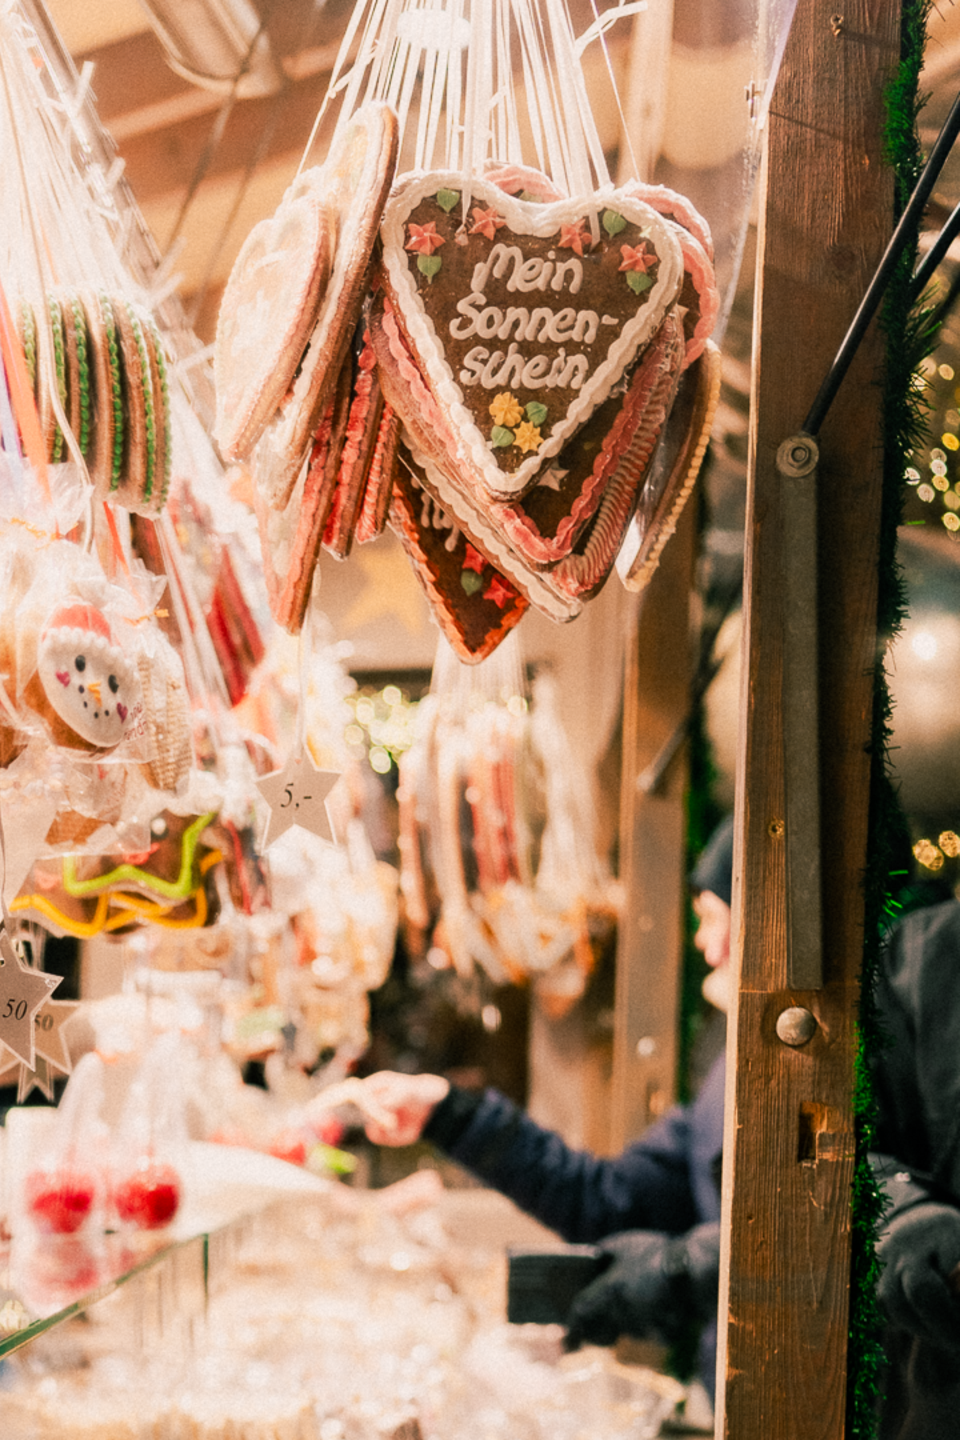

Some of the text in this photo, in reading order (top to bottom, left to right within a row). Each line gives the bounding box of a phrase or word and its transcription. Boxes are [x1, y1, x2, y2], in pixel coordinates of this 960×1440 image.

[470, 242, 584, 294] Mein
[448, 291, 620, 344] Sonnen-
[280, 782, 312, 811] 5,-
